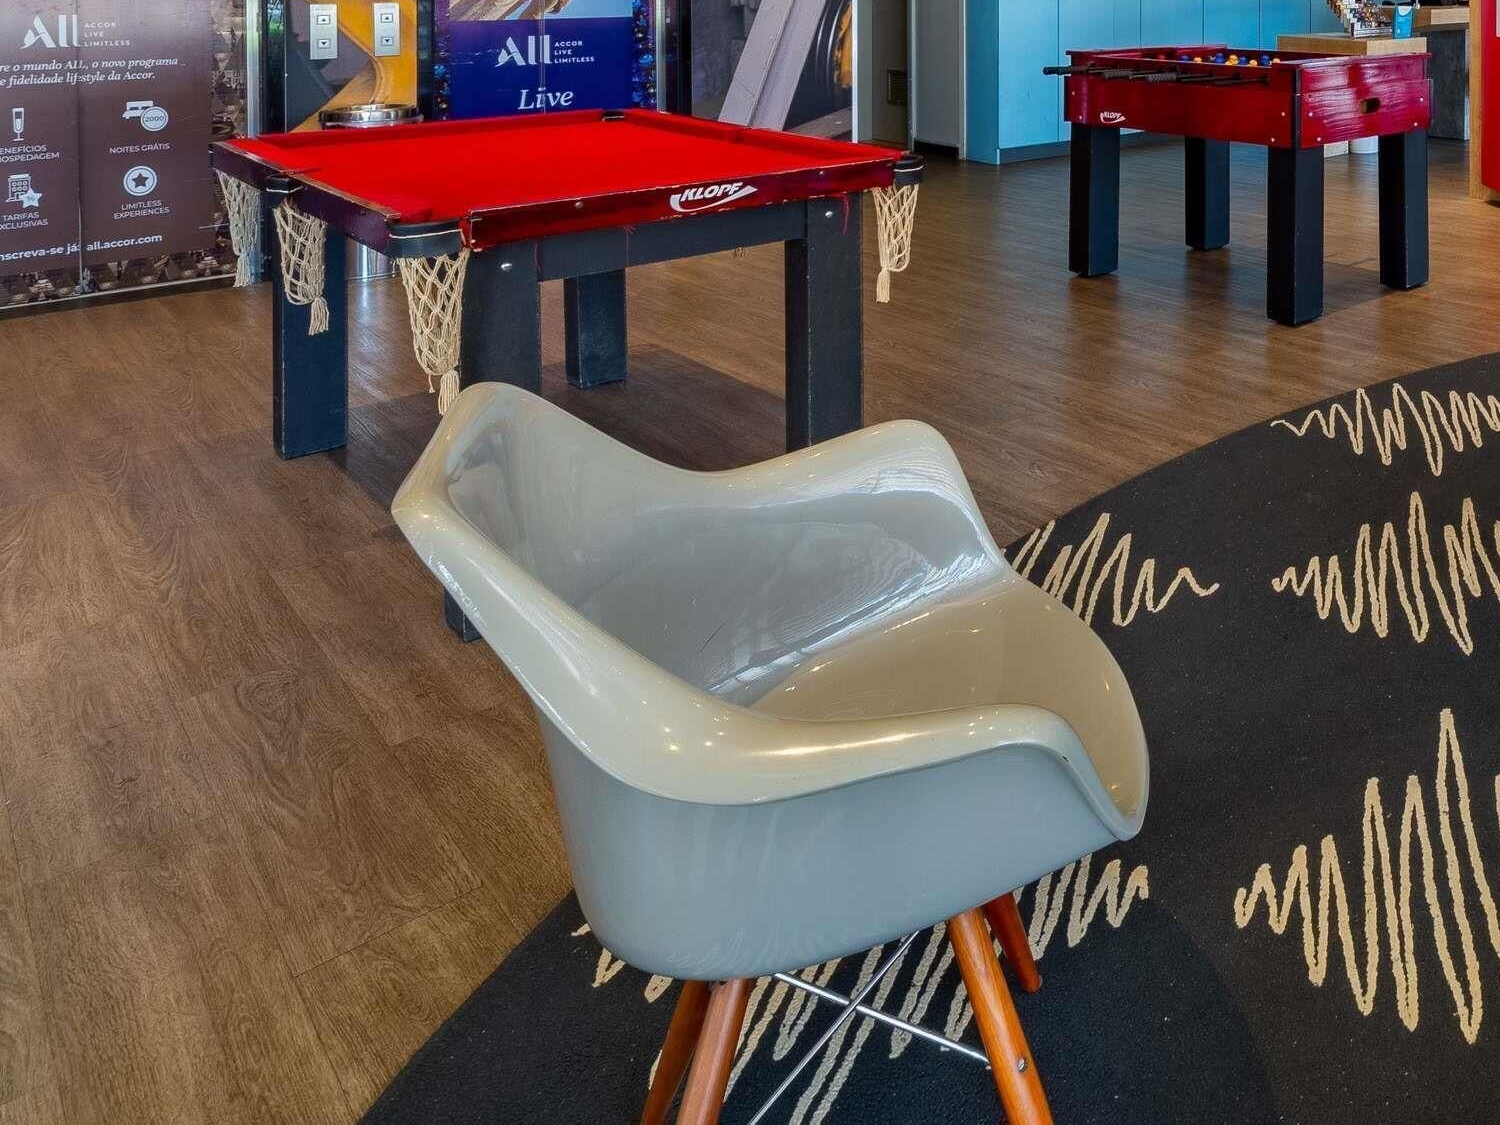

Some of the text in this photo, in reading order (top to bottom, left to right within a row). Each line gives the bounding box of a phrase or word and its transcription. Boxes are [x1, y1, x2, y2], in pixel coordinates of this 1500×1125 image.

[84, 39, 131, 48] LIMITLESS
[13, 64, 20, 72] o
[23, 60, 63, 72] mundo
[92, 61, 99, 69] o
[101, 60, 126, 69] novo
[128, 57, 178, 70] programa
[7, 74, 64, 89] fidelidade
[66, 72, 105, 86] lifestyle
[107, 73, 121, 81] da
[122, 71, 156, 82] Accor.
[517, 87, 574, 110] Live
[0, 144, 47, 156] ENEFÍCIOS
[109, 141, 171, 154] NOITES GRÁTIS
[680, 182, 743, 202] KLOPF
[121, 200, 162, 211] LIMITLESS
[3, 211, 39, 222] TARIFAS
[113, 206, 170, 219] EXPERIENCES
[0, 219, 49, 231] XCLUSIVAS
[86, 234, 163, 252] all.accor.com
[0, 246, 64, 262] nscreva-se
